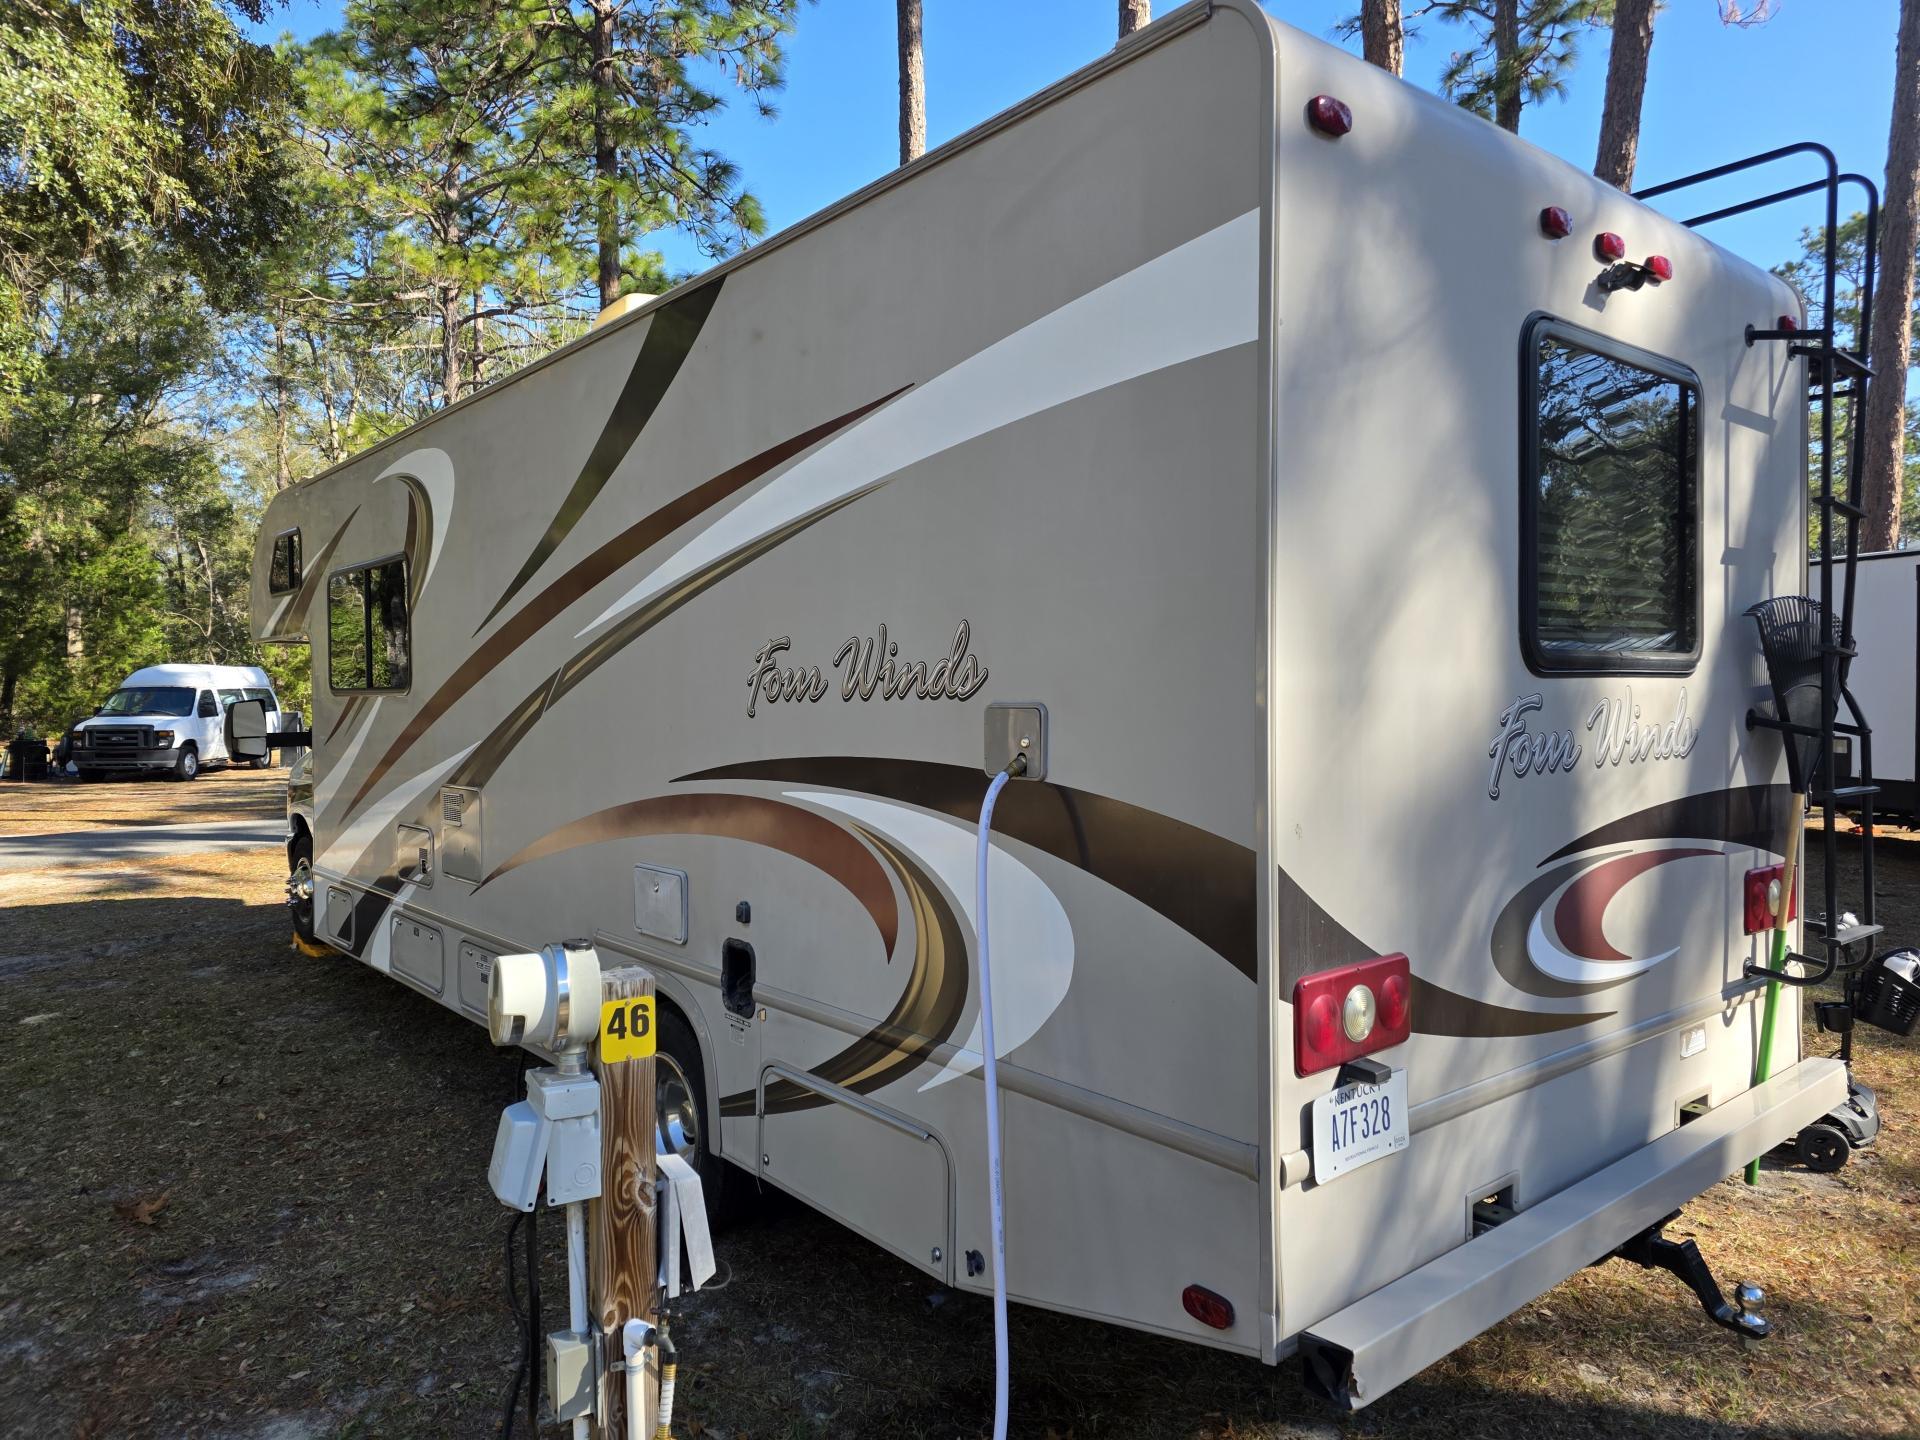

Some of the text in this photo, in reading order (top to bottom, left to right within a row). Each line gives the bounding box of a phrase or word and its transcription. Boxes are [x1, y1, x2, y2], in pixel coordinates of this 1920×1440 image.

[747, 619, 988, 718] Four Winds
[1488, 685, 1698, 800] Four Winds
[606, 1003, 650, 1040] 46
[1332, 1096, 1391, 1152] A7F328
